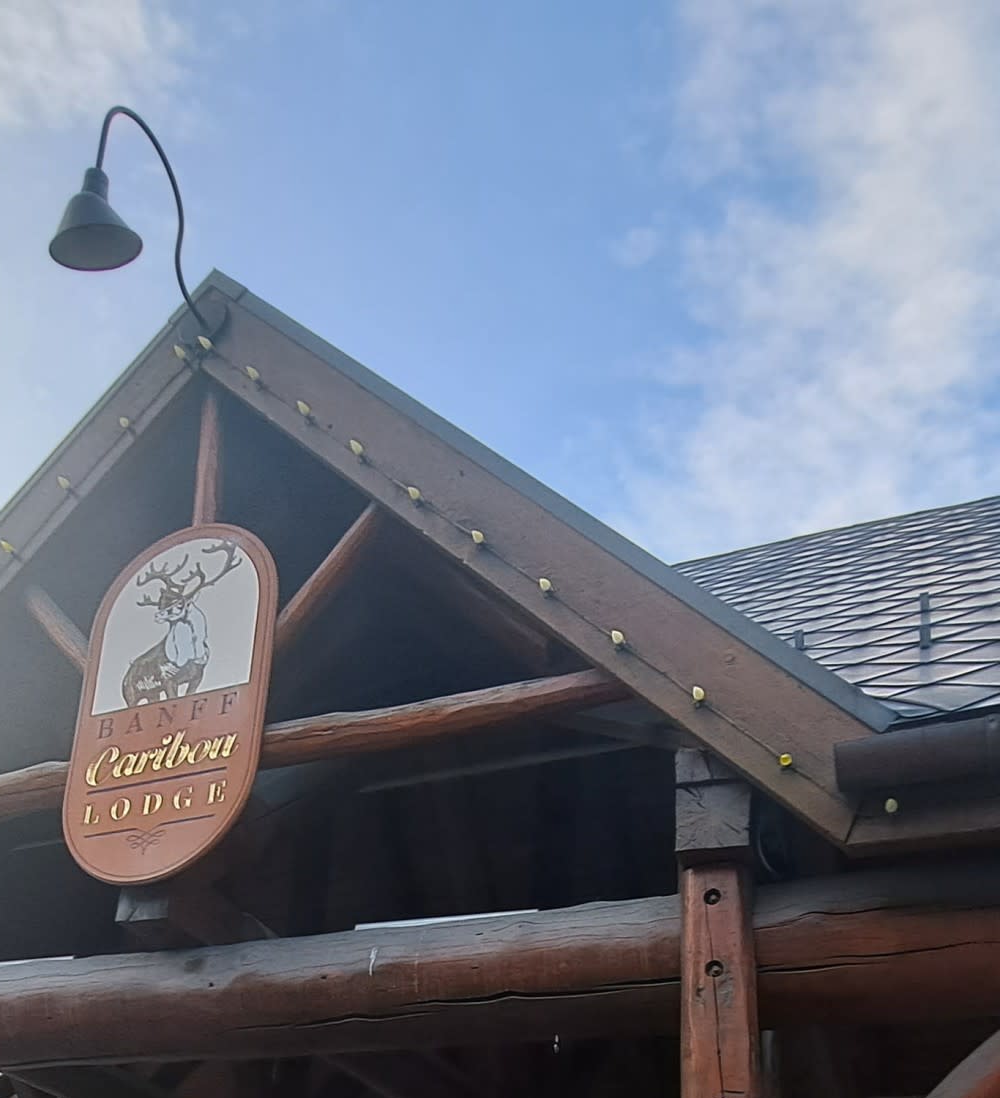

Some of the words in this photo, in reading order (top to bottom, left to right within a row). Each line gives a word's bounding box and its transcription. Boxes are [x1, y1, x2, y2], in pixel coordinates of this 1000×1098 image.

[97, 691, 239, 740] BANFF
[86, 730, 239, 786] Caribou
[83, 780, 228, 825] LODGE
